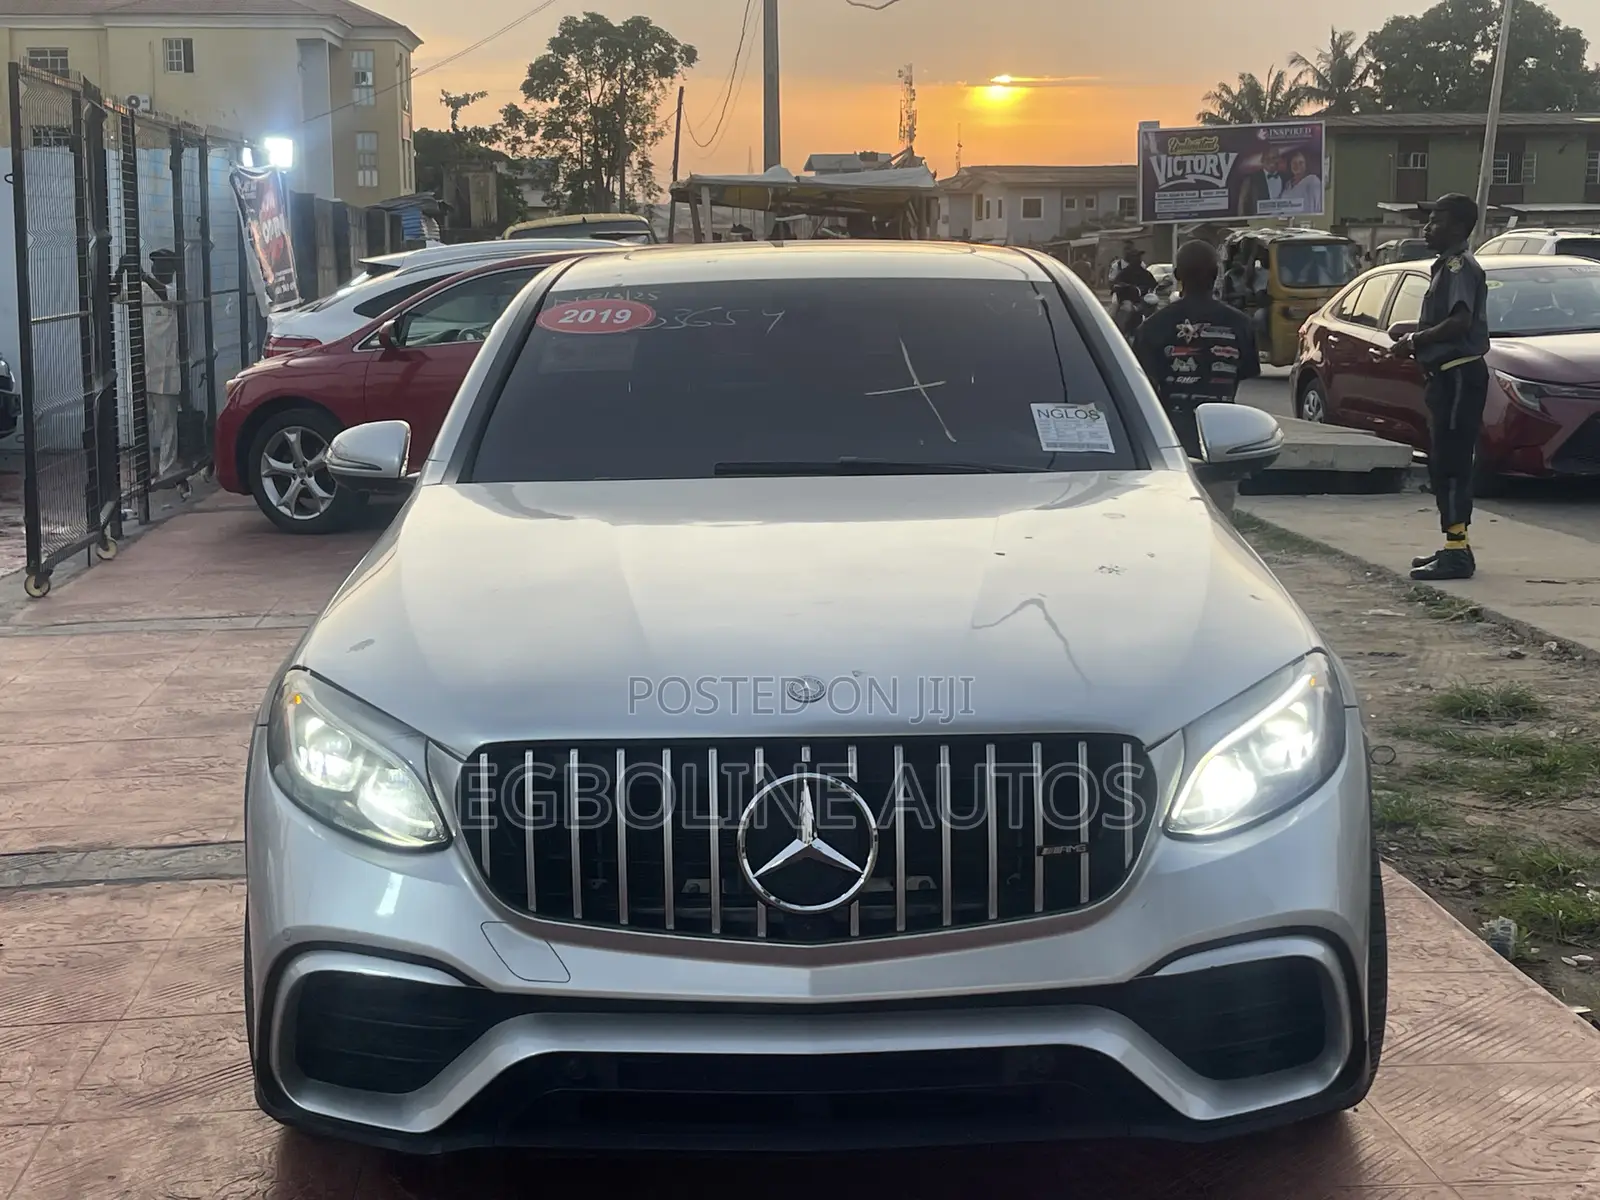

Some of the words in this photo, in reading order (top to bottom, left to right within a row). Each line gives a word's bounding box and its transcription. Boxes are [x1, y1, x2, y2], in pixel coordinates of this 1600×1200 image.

[1269, 128, 1312, 137] INSPIRED
[1150, 153, 1238, 189] VICTORY
[558, 308, 632, 324] 2019
[1061, 844, 1087, 853] AMG
